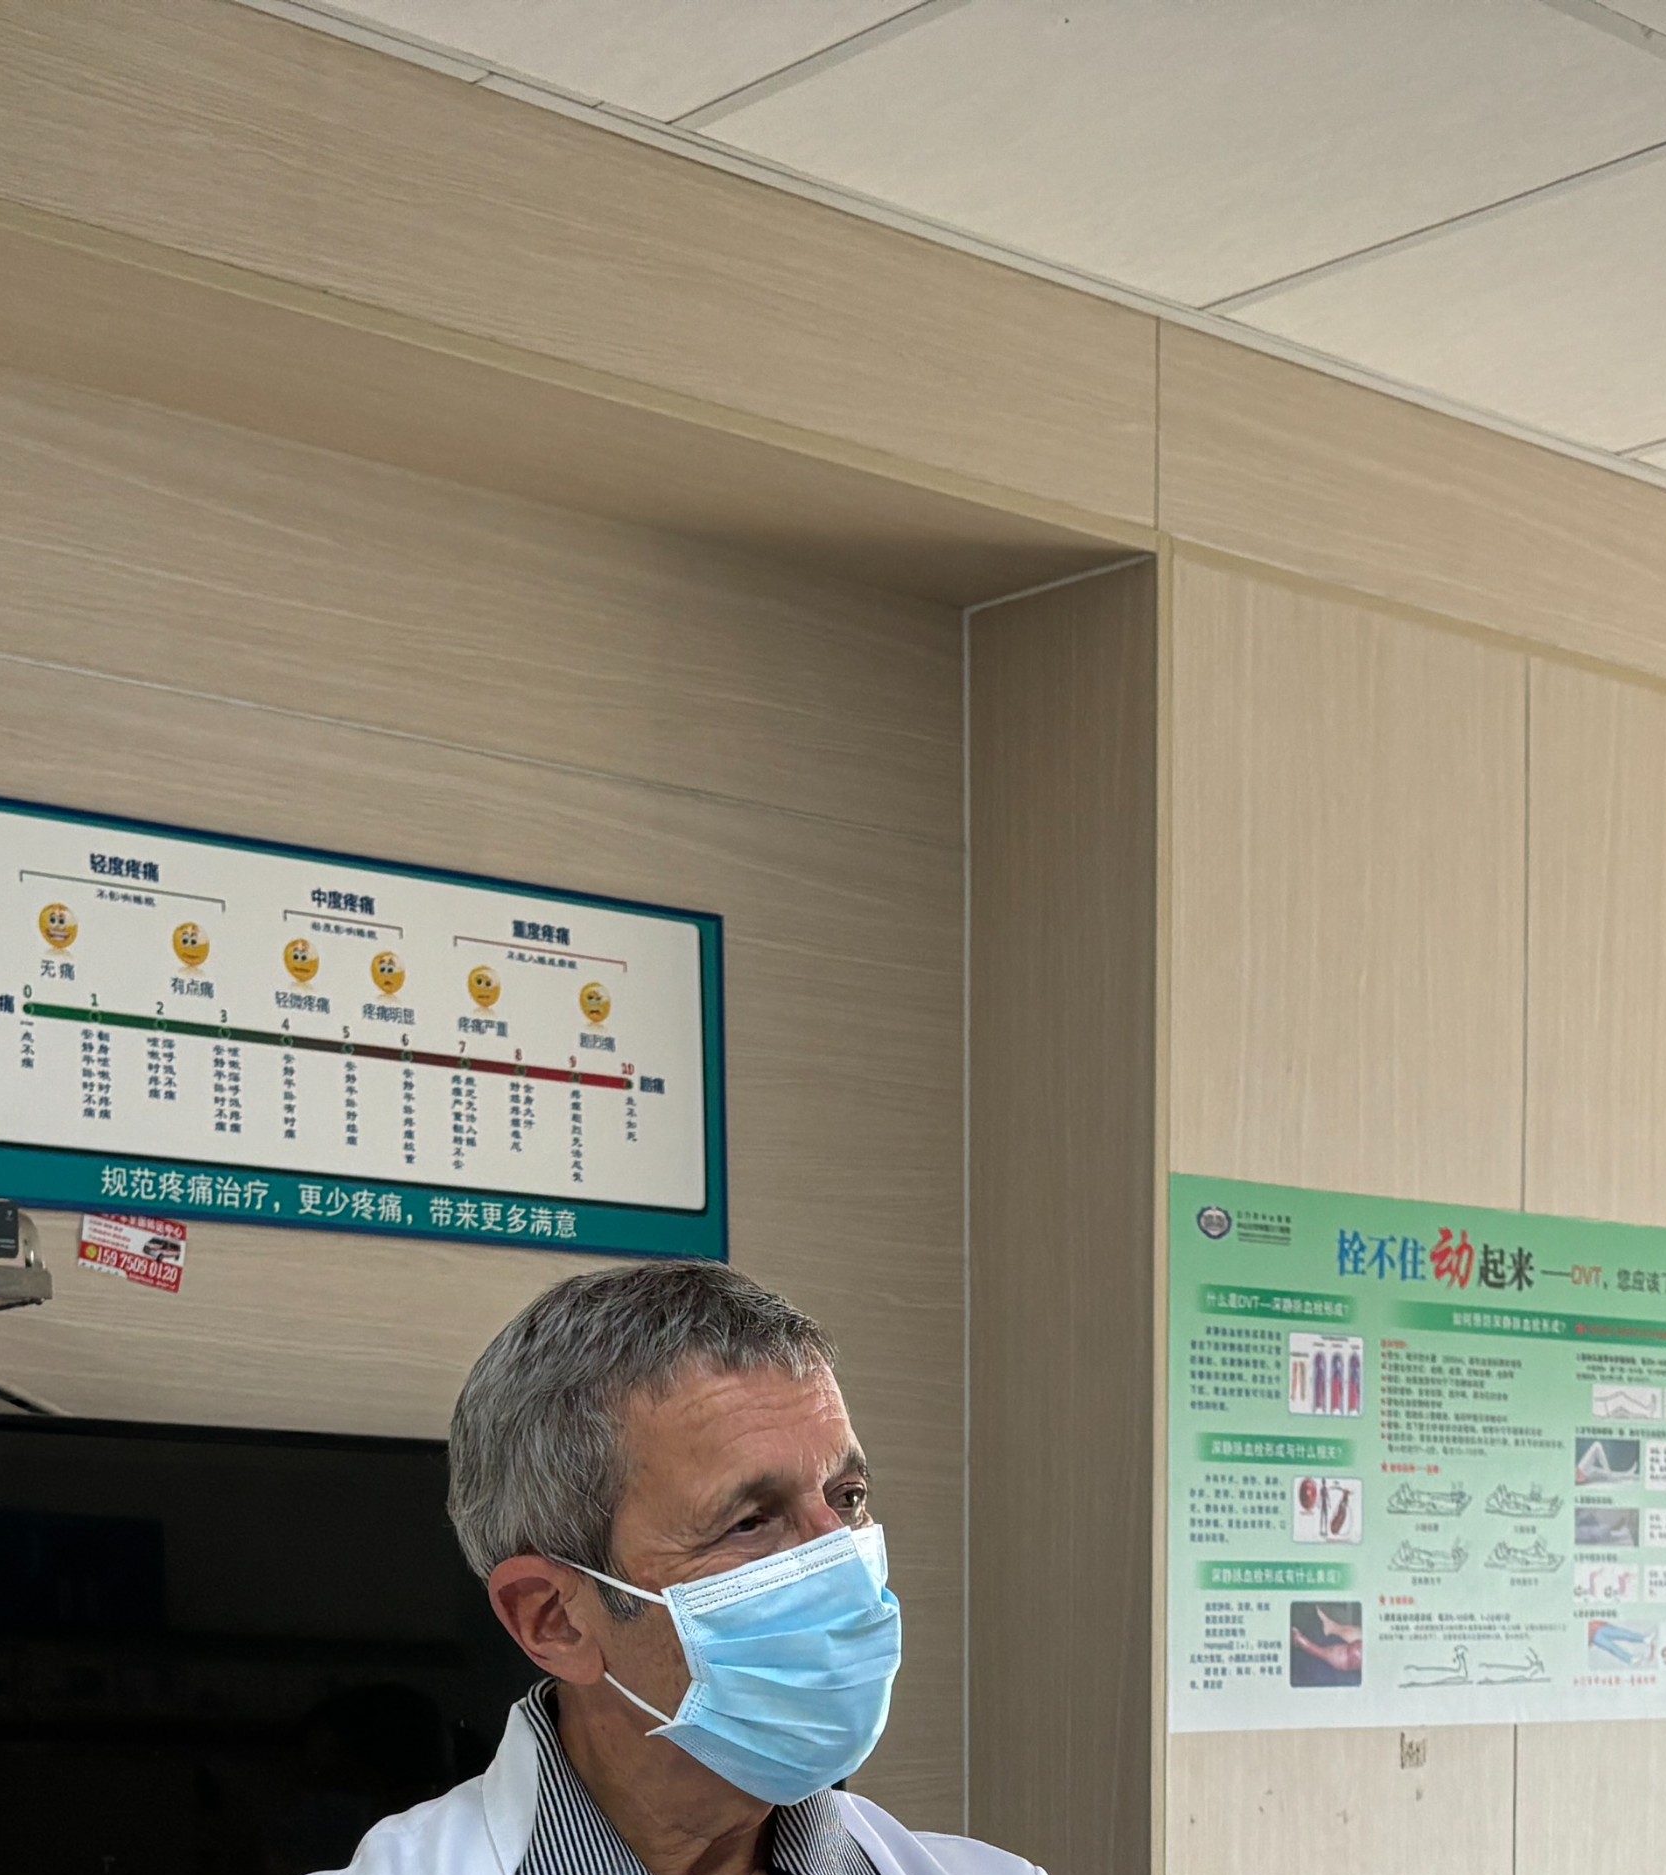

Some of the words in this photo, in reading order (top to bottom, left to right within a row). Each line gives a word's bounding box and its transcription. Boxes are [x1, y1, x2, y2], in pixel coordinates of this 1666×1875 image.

[89, 852, 160, 883] 轻度疼痛
[310, 887, 375, 916] 中度疼痛
[511, 919, 571, 947] 重度疼痛
[40, 958, 76, 981] 无痛
[23, 985, 32, 999] 0
[170, 976, 215, 999] 有点痛
[90, 993, 99, 1007] 1
[155, 1001, 165, 1015] 2
[274, 990, 331, 1015] 轻微疼痛
[219, 1009, 228, 1023] 3
[281, 1018, 290, 1031] 4
[361, 1002, 416, 1026] 疼痛明显
[342, 1025, 351, 1039] 5
[456, 1015, 509, 1038] 疼痛严重
[19, 1020, 35, 1069] 一点不痛
[401, 1033, 410, 1047] 6
[458, 1041, 467, 1054] 7
[515, 1048, 523, 1061] 8
[569, 1055, 577, 1068] 9
[621, 1062, 635, 1075] 10
[100, 1164, 578, 1240] 规范疼痛治疗，更少疼痛，带来更多满意
[96, 1246, 118, 1266] 159
[149, 1261, 178, 1284] 0120
[1335, 1227, 1535, 1292] 栓不住动起来
